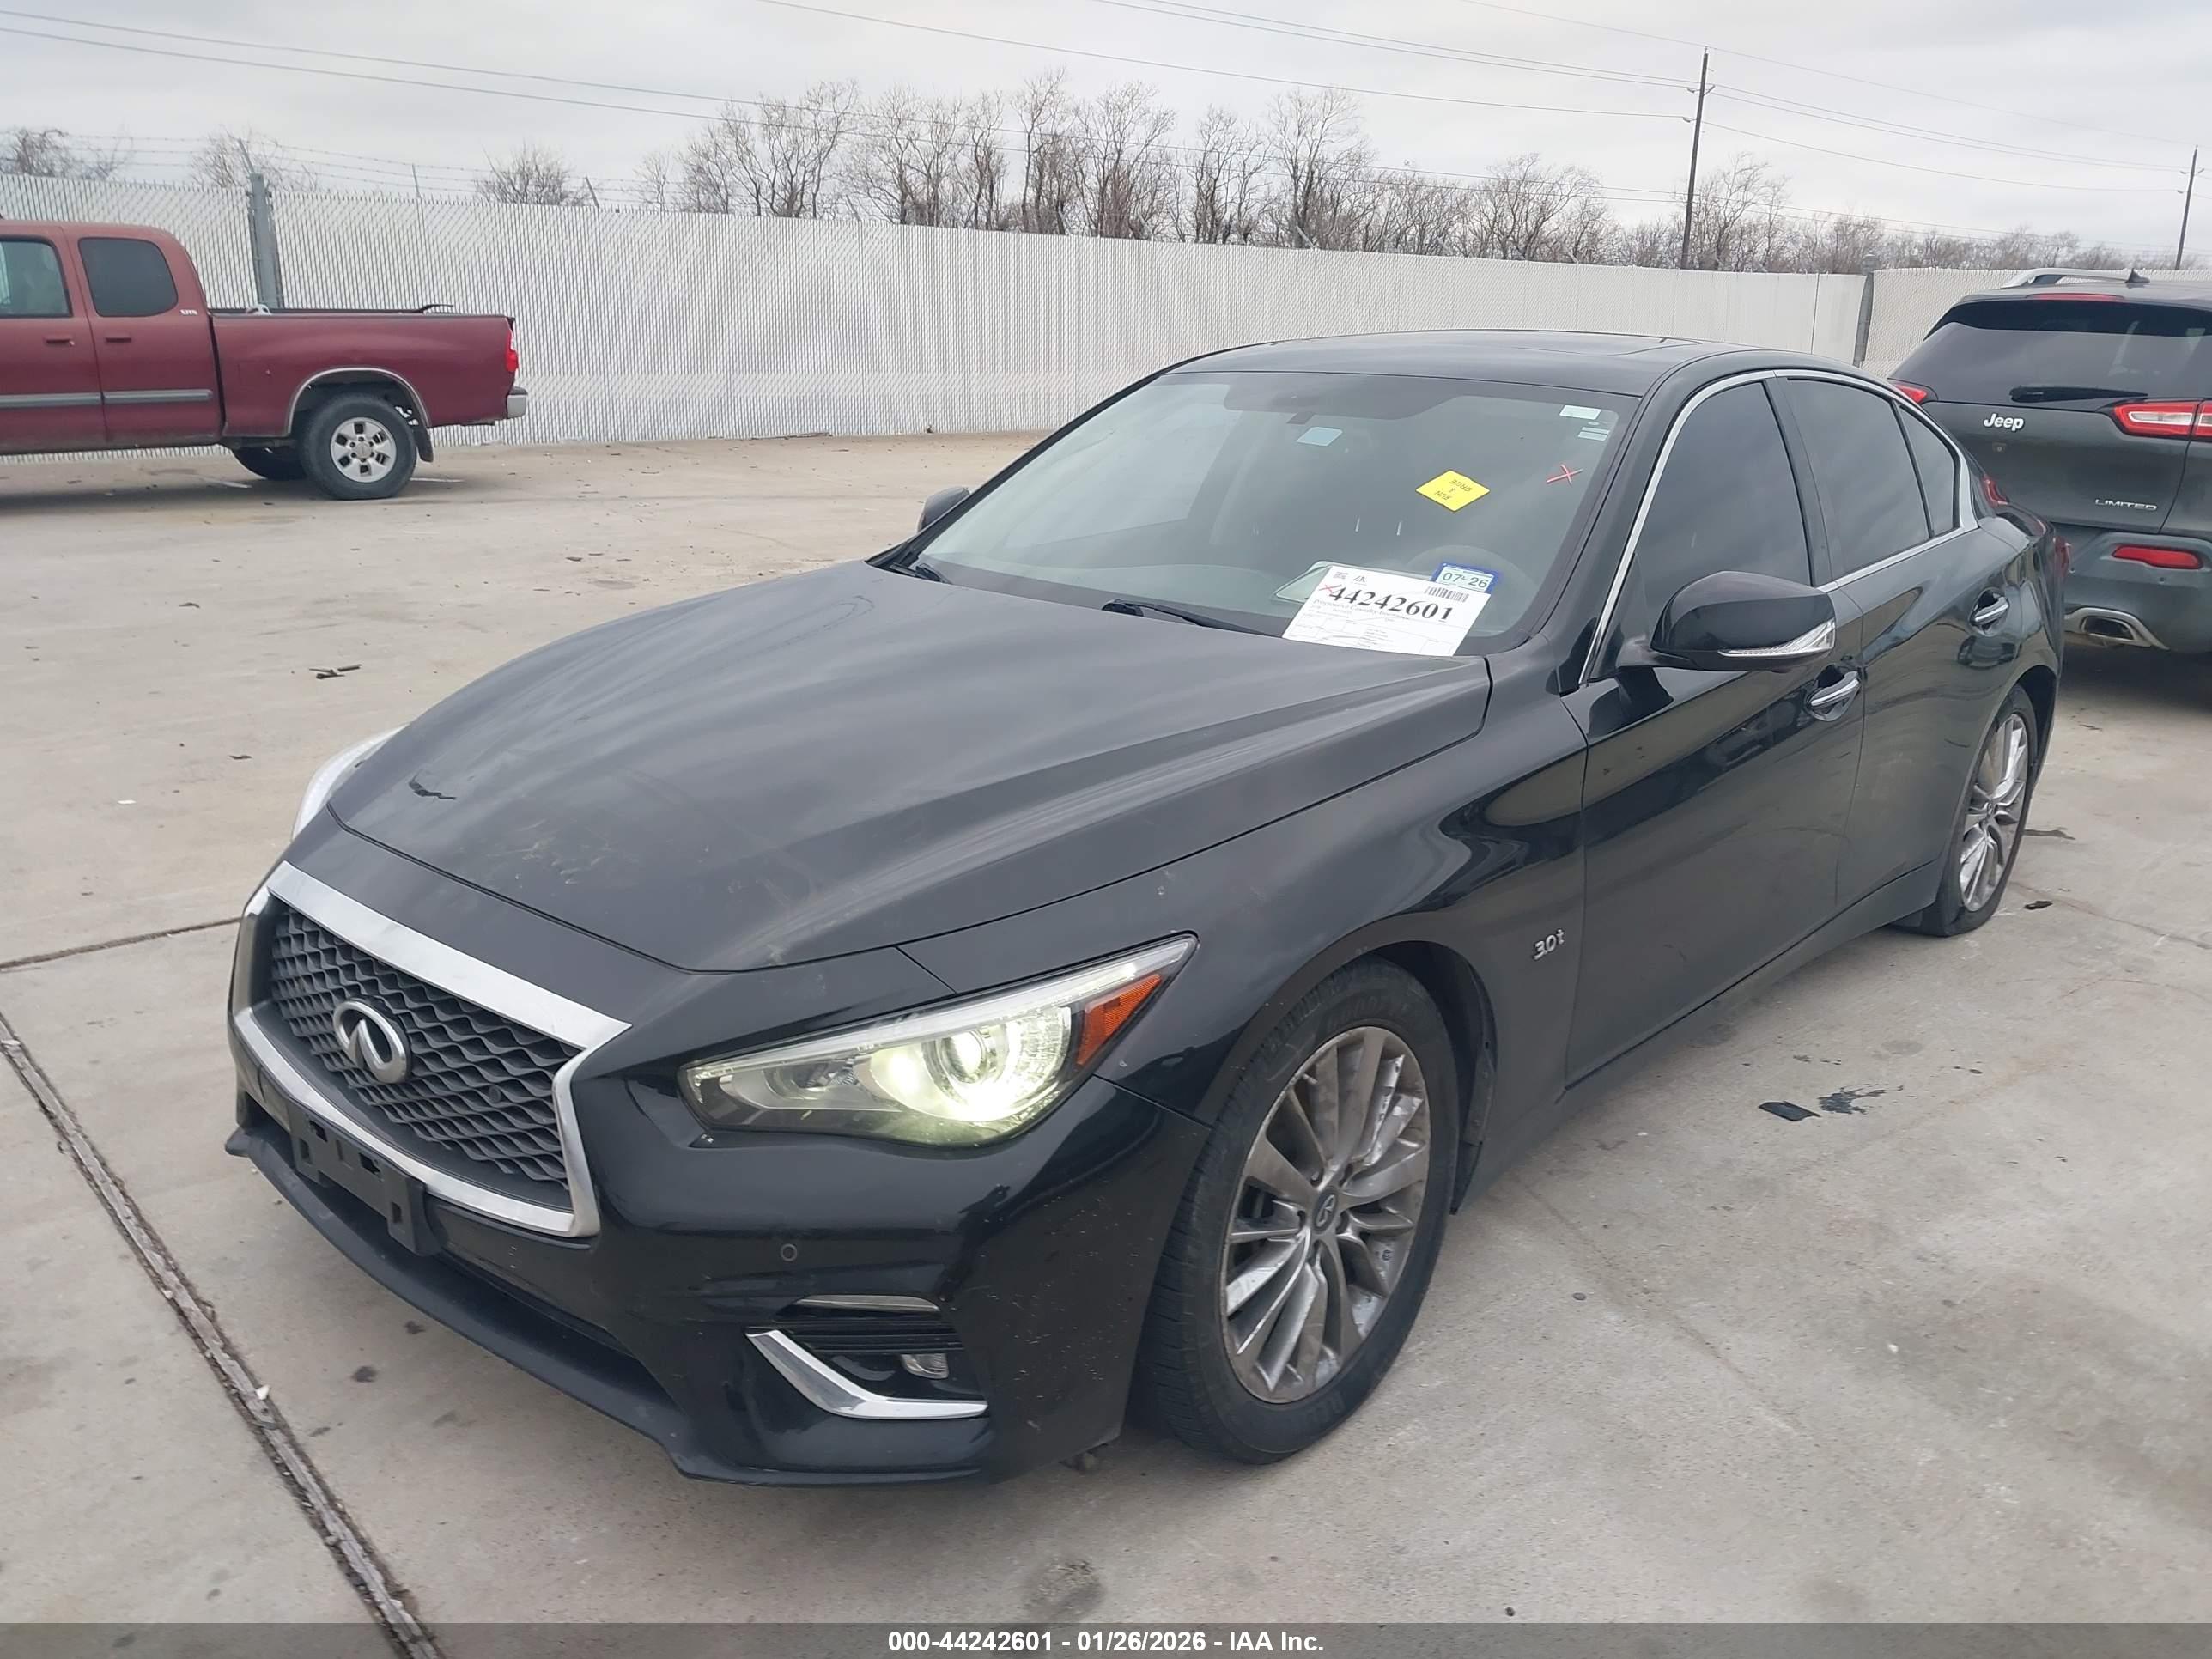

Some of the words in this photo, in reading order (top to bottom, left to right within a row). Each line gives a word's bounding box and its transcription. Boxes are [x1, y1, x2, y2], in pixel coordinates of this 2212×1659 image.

[1984, 413, 2024, 431] Jeep
[2095, 499, 2157, 510] LIMITED
[1328, 586, 1453, 620] 44242601
